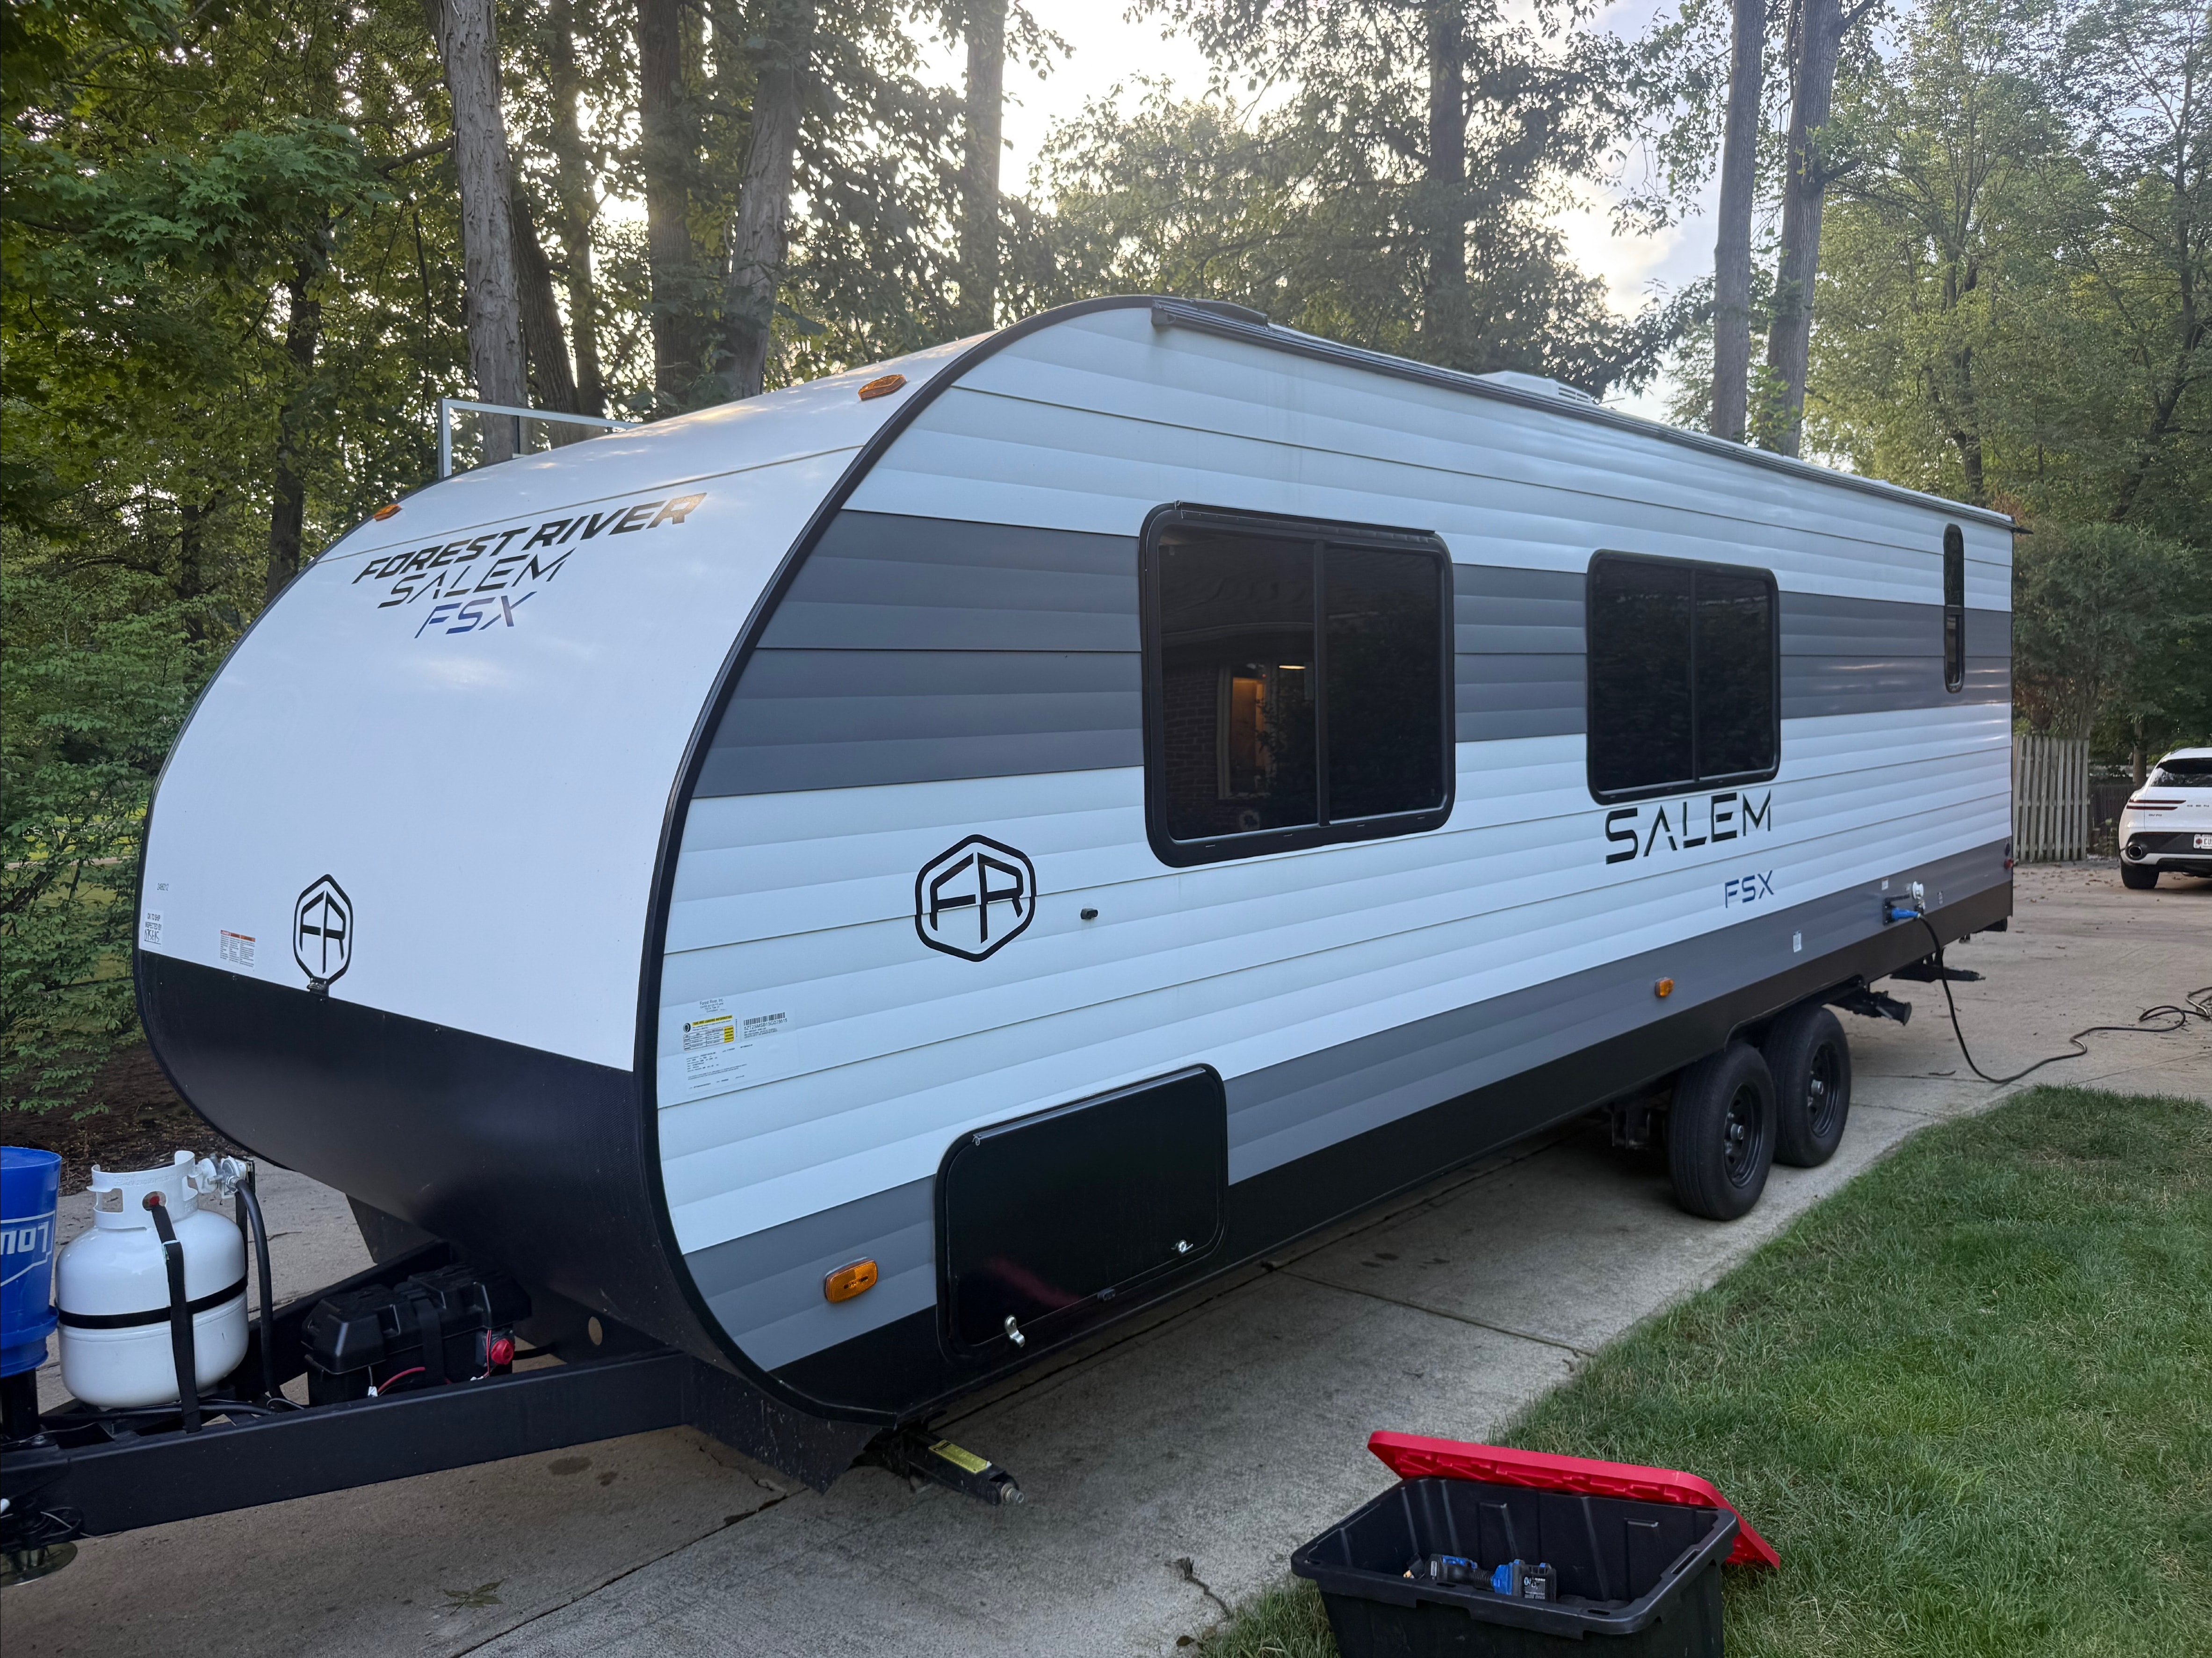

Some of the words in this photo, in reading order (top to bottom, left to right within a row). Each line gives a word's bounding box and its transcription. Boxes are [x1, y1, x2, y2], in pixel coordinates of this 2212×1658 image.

[352, 526, 529, 584] FOREST
[522, 492, 707, 551] RIVER
[377, 547, 577, 609] SALEM
[414, 591, 537, 639] FSX
[1605, 788, 1771, 865] SALEM
[1725, 870, 1774, 908] FSX
